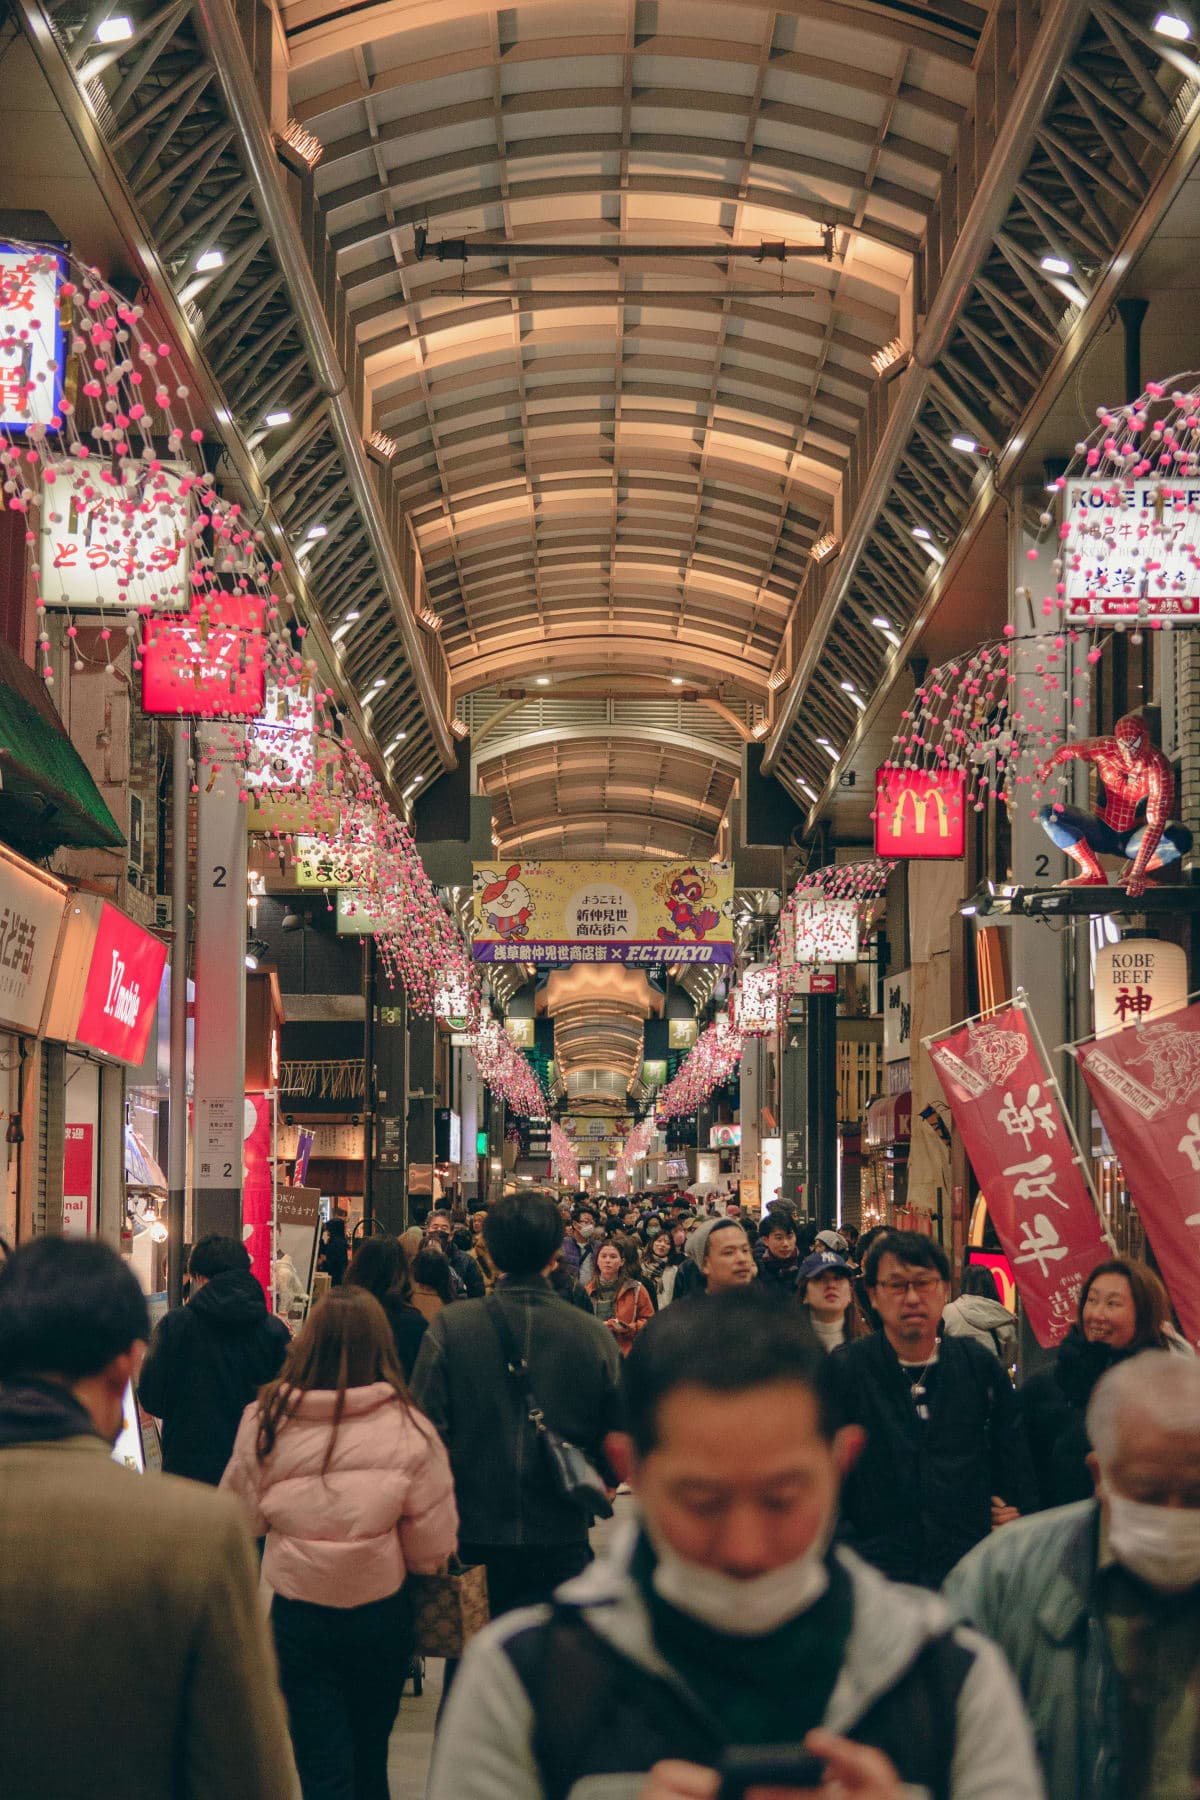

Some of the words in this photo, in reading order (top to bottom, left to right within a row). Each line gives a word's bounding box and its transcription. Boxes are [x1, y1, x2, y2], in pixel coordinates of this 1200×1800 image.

[1035, 855, 1049, 877] 2
[212, 866, 227, 888] 2
[582, 895, 622, 905] ようこそ!
[577, 909, 628, 922] 新仲見世
[577, 923, 628, 936] 商店街へ
[494, 945, 607, 961] 浅草新仲見世商店街
[1112, 953, 1155, 968] KOBE
[1113, 970, 1154, 984] BEEF
[1113, 985, 1153, 1022] 神
[387, 1010, 395, 1024] 3
[790, 1036, 798, 1048] 4
[223, 1163, 233, 1178] 2
